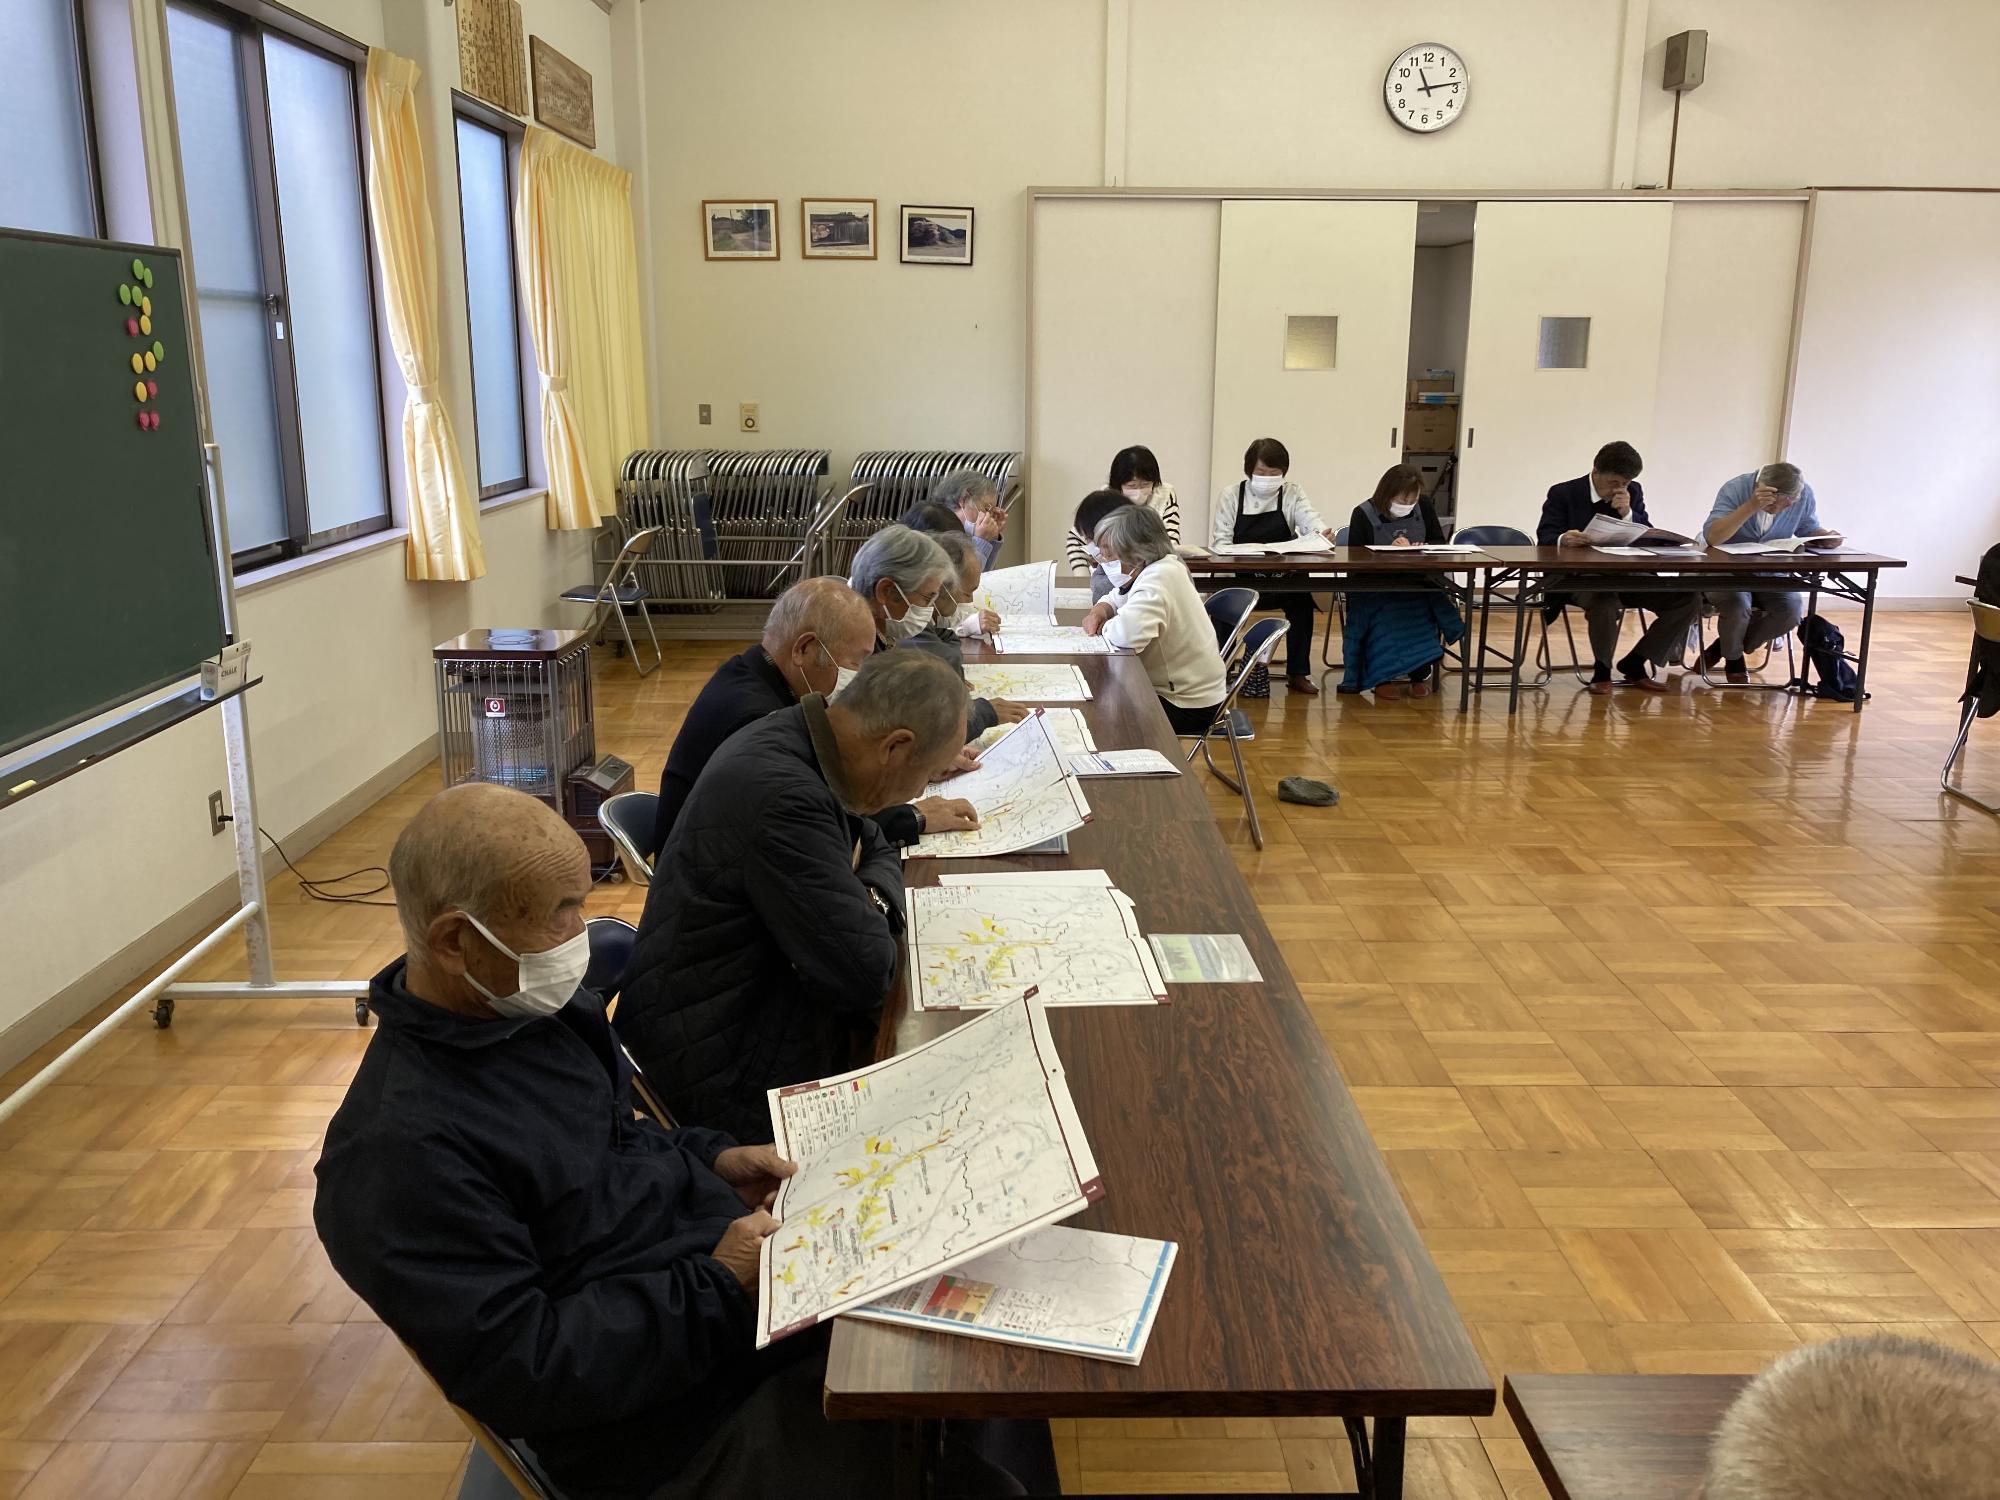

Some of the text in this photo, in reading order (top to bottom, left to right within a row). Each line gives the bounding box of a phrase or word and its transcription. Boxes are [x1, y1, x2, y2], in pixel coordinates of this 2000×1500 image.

[1409, 57, 1419, 67] 11
[1423, 52, 1434, 62] 12
[1440, 57, 1445, 67] 1
[1399, 68, 1411, 78] 10
[1449, 68, 1456, 77] 2
[1395, 83, 1402, 93] 9
[1452, 83, 1458, 93] 3
[1398, 99, 1405, 108] 8
[1446, 99, 1453, 108] 4
[1408, 110, 1415, 119] 7
[1421, 114, 1428, 123] 6
[1436, 110, 1443, 120] 5
[221, 666, 237, 677] CHALK
